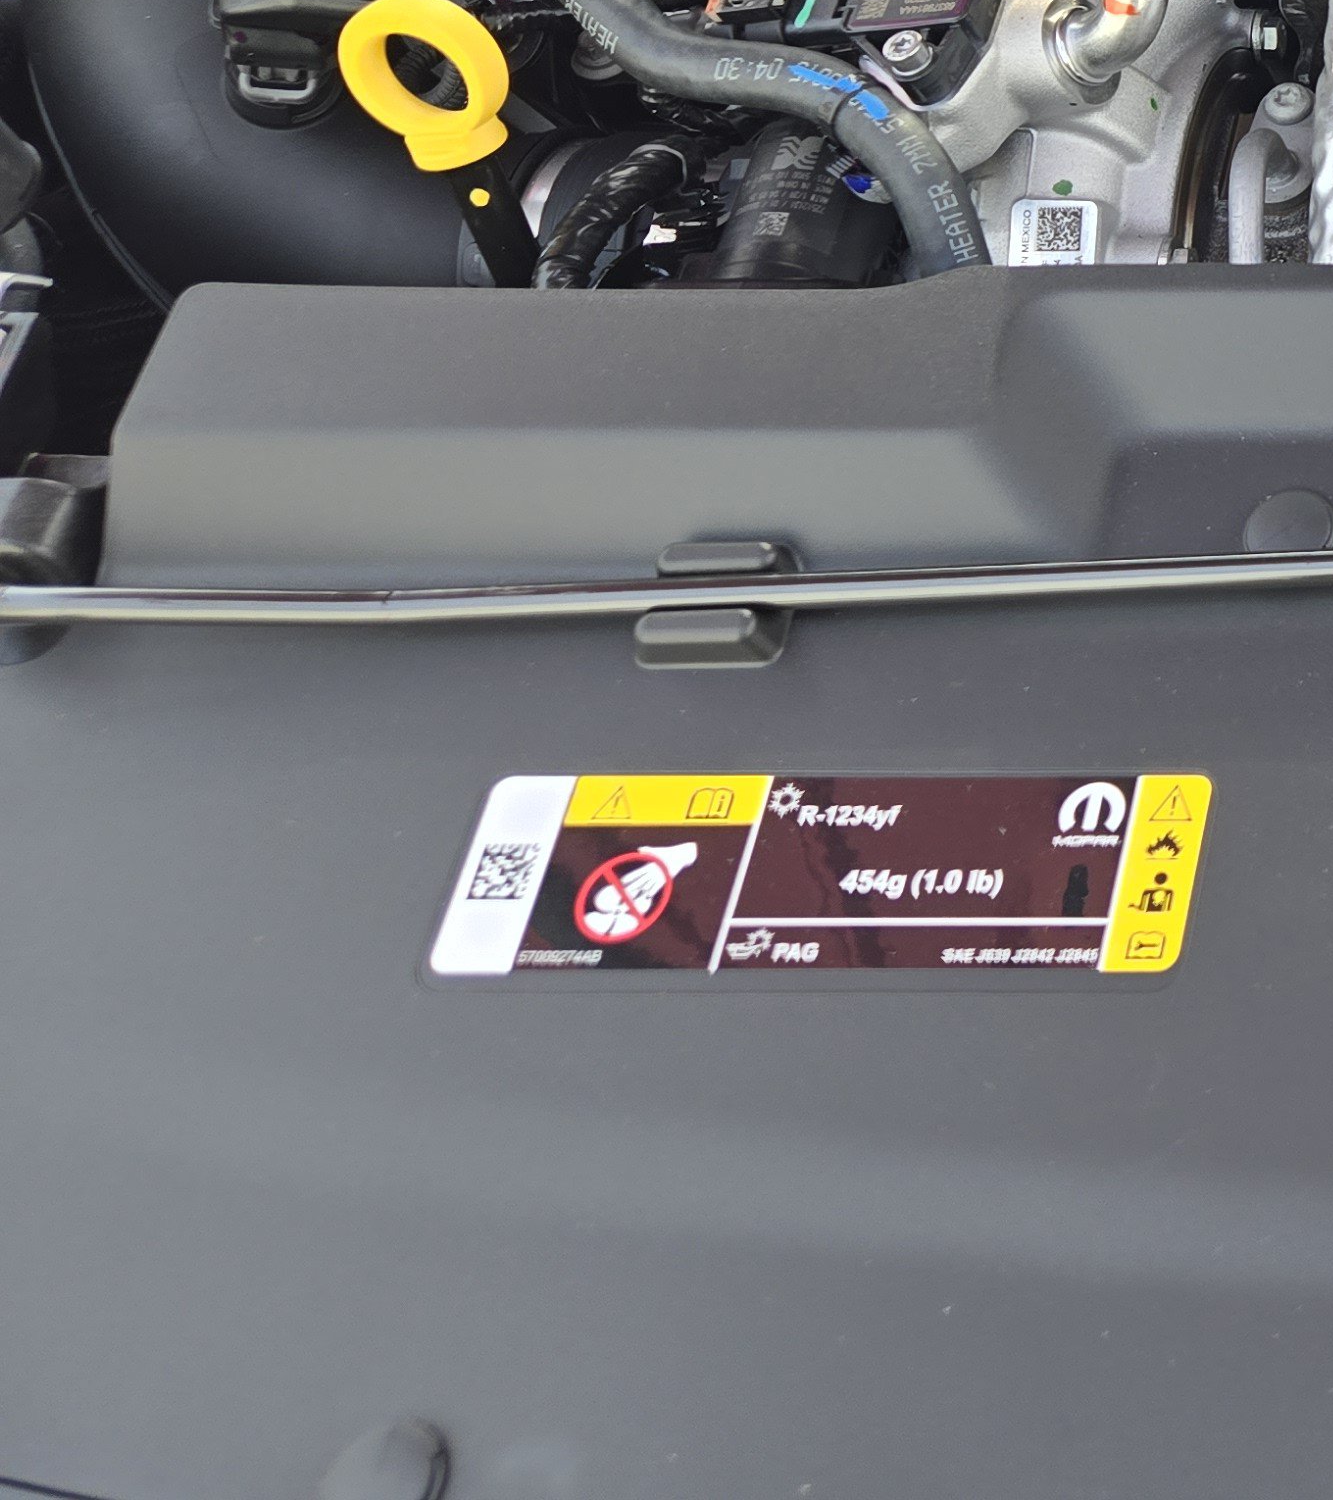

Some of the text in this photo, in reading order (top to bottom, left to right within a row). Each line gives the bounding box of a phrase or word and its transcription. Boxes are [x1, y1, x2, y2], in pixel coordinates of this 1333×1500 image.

[713, 57, 785, 81] 04:30
[895, 134, 979, 265] HEATER 7MM
[1021, 209, 1032, 253] MEXICO
[797, 804, 903, 831] R-1234yf
[1051, 834, 1121, 848] MOPAR
[838, 868, 1005, 901] 454g (1.0 lb)
[770, 941, 820, 963] PAG
[940, 947, 976, 964] SAE
